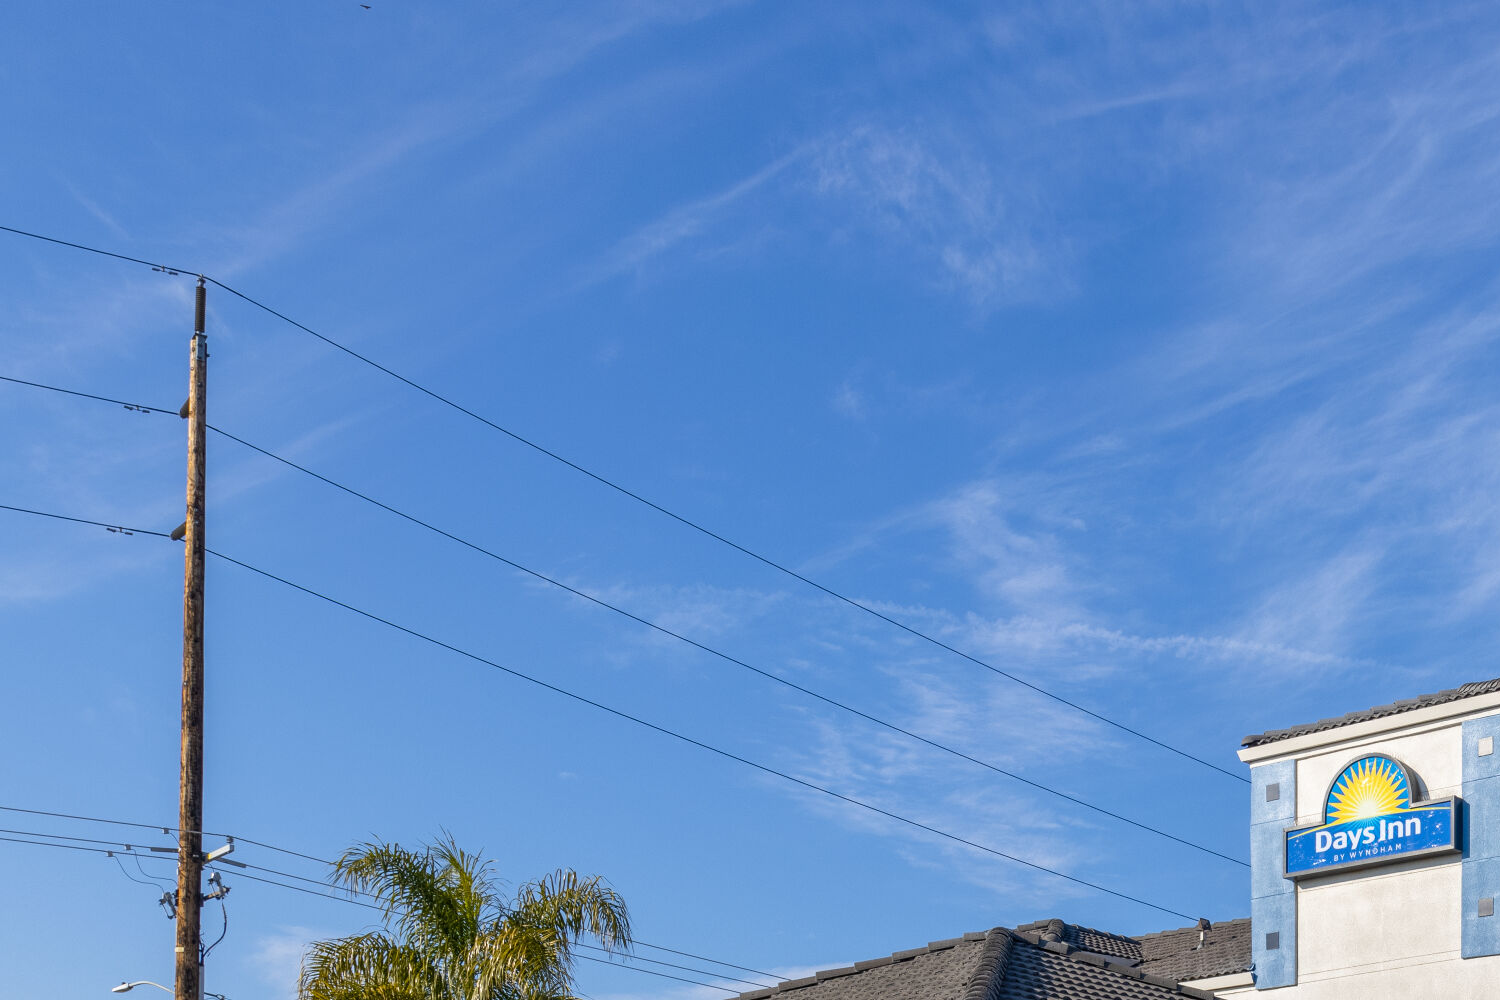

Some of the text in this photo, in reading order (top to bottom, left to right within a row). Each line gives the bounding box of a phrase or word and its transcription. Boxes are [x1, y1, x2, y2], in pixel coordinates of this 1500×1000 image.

[1315, 817, 1421, 853] Days Inn
[1333, 843, 1402, 862] BY WYNDHAM
